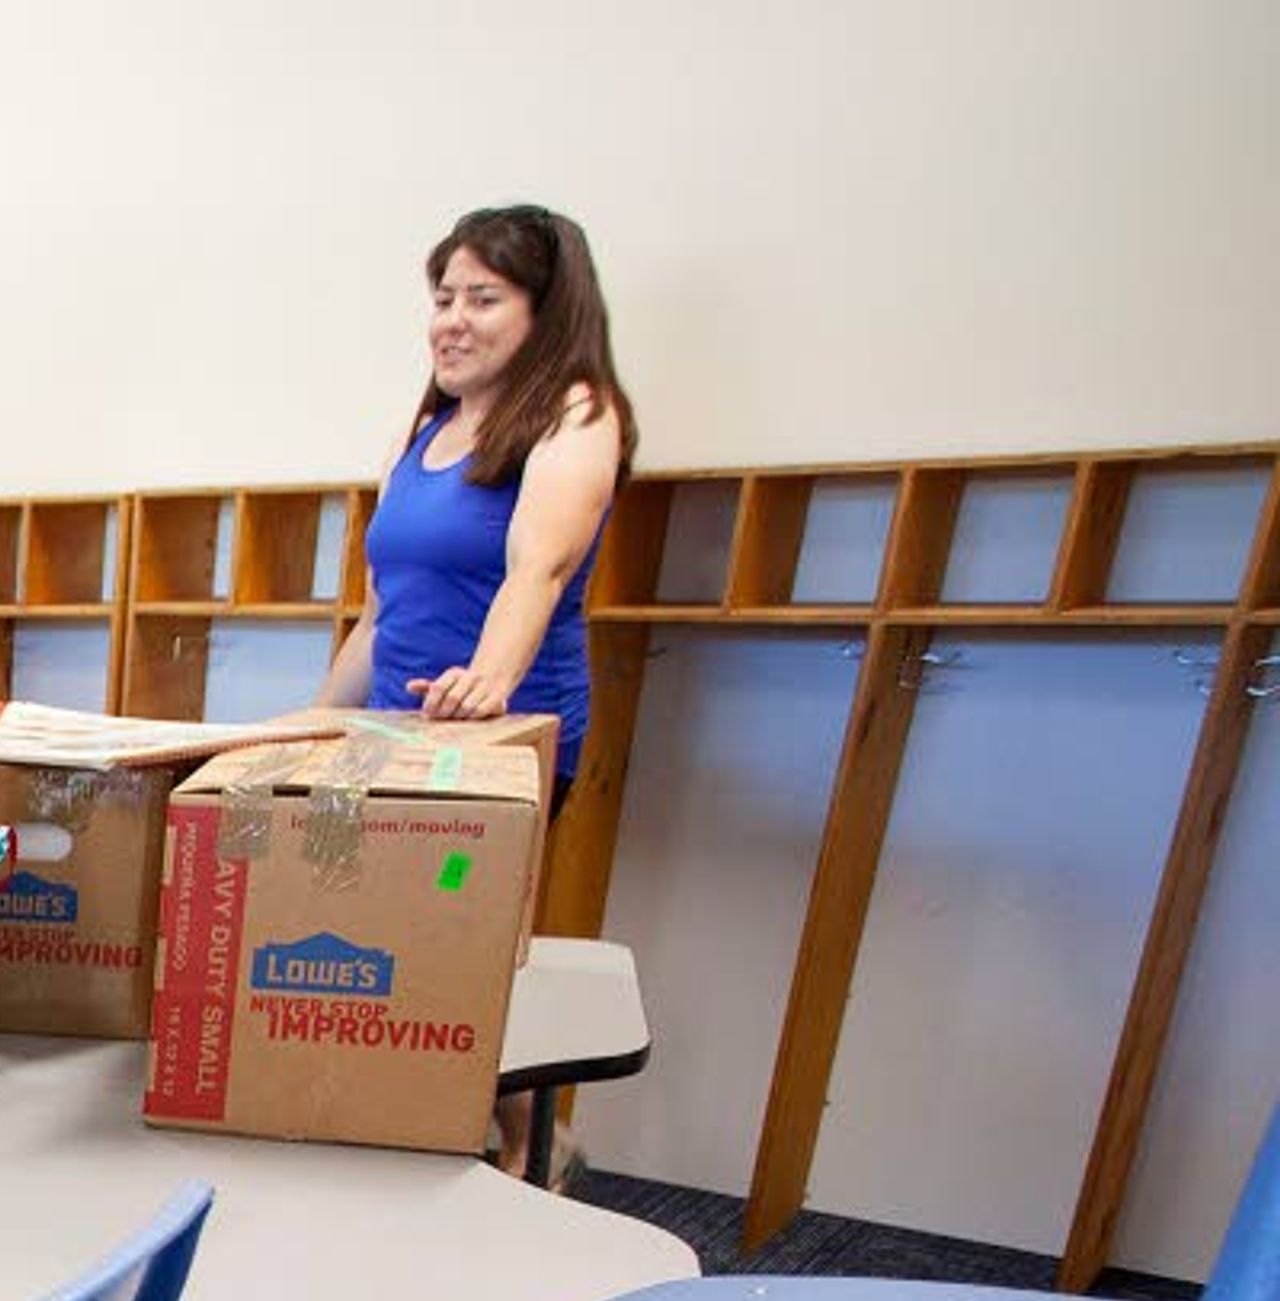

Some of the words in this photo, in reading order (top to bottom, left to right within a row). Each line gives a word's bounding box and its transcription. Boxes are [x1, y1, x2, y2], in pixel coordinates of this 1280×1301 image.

[207, 923, 231, 1000] DUTY
[267, 953, 378, 990] LOWE'S
[250, 995, 327, 1017] NEVER
[333, 1002, 388, 1022] STOP
[196, 1005, 225, 1096] SMALL
[268, 1016, 477, 1053] IMPROVING
